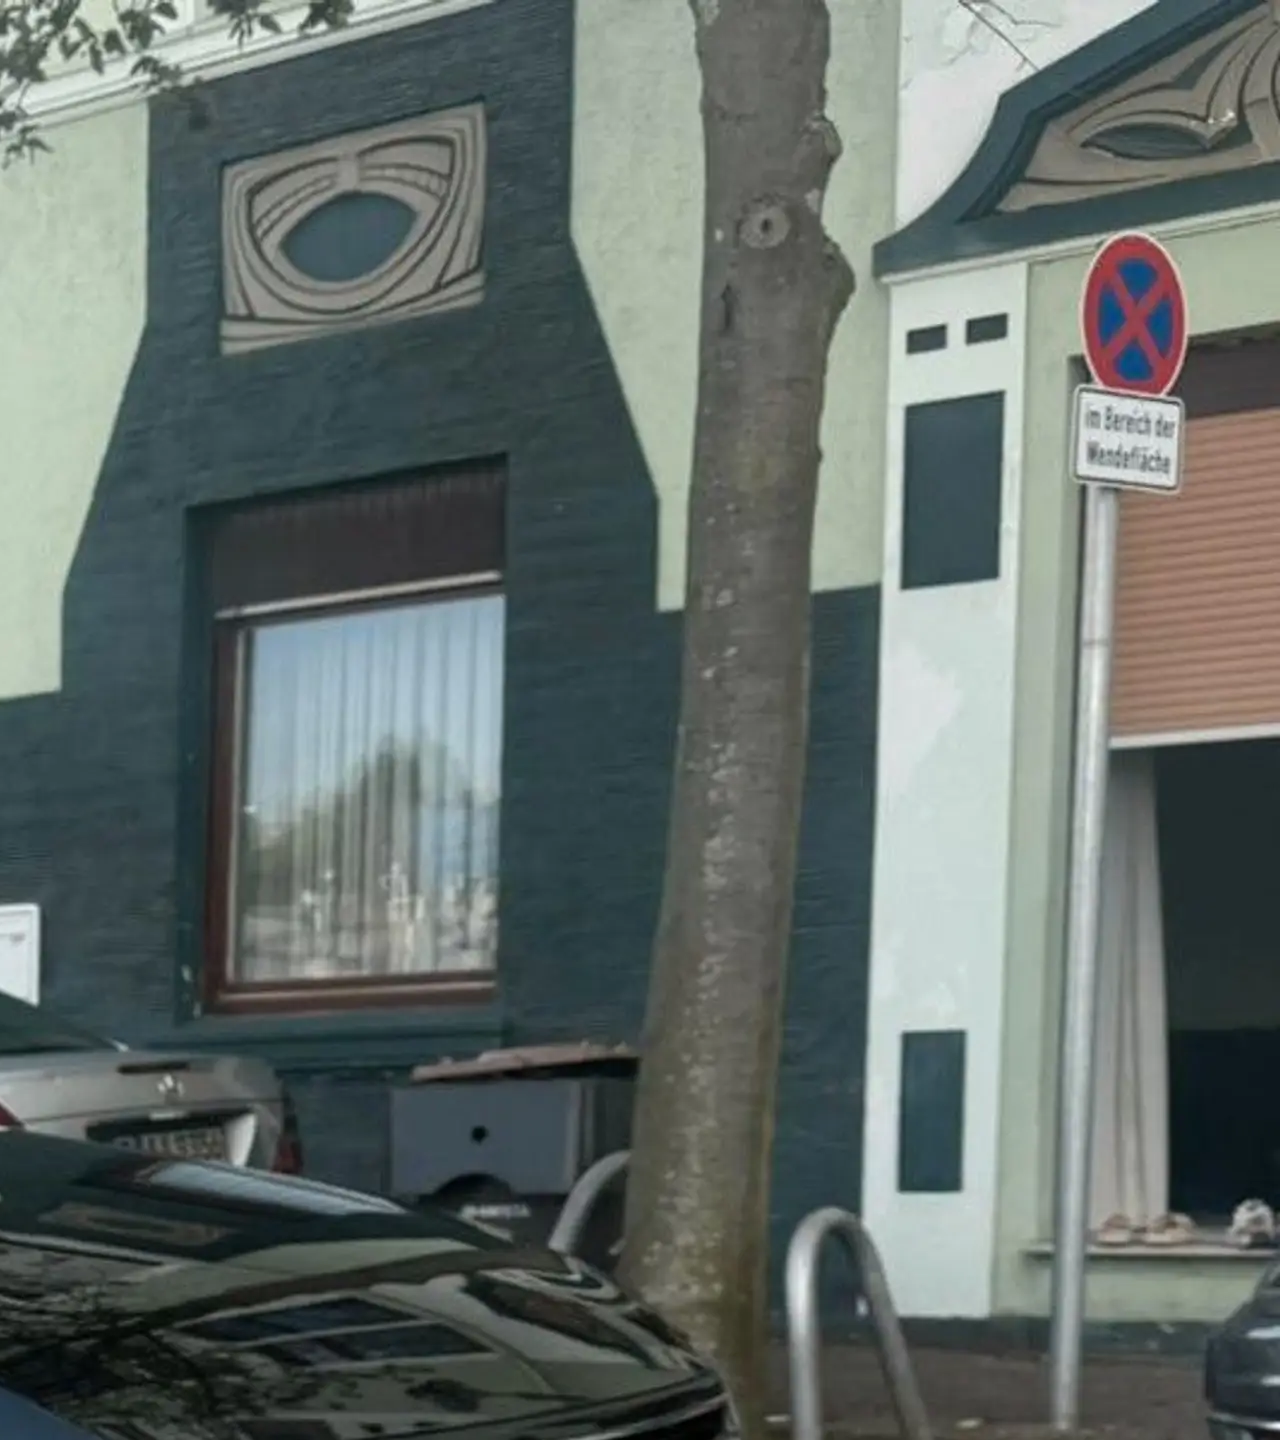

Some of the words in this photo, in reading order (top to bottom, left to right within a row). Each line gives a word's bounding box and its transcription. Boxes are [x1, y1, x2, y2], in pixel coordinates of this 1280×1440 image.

[1104, 405, 1151, 436] Bereich
[1155, 413, 1175, 438] der
[1086, 440, 1170, 474] Wendefläche
